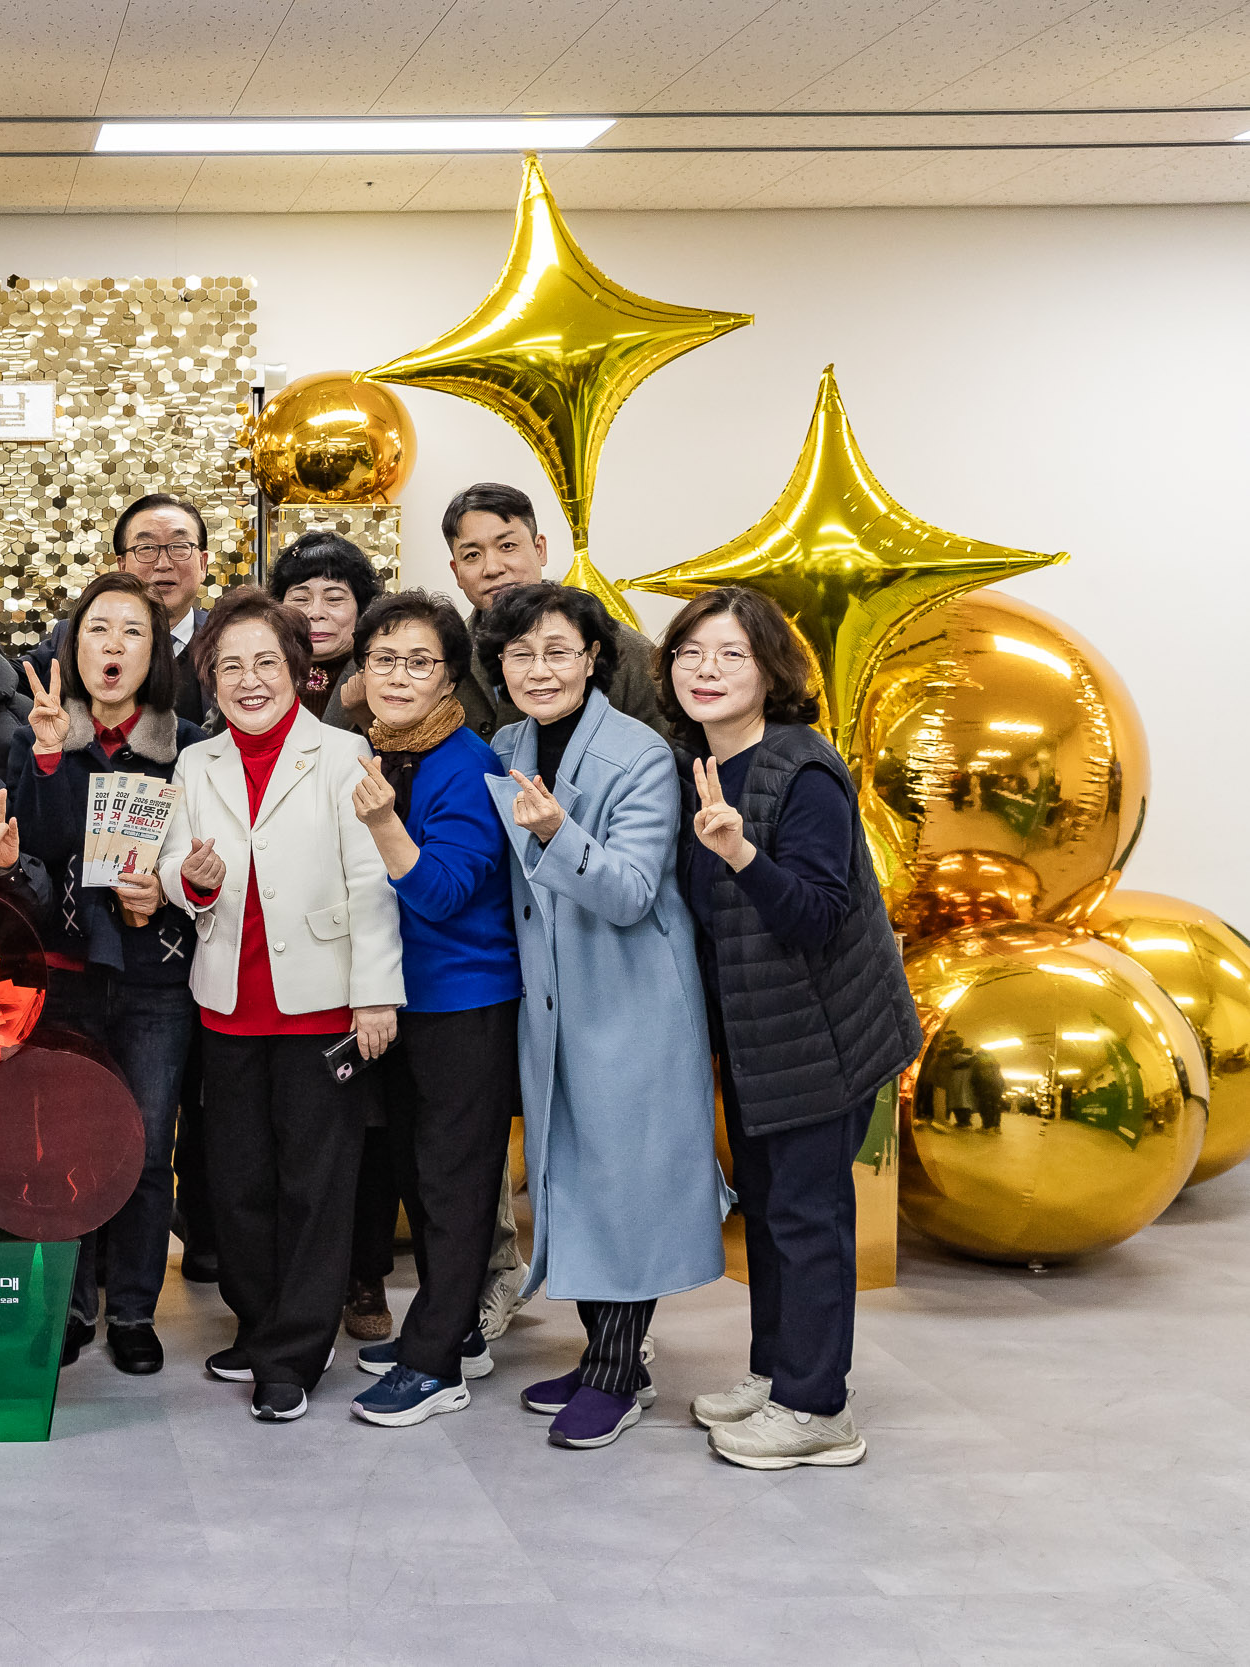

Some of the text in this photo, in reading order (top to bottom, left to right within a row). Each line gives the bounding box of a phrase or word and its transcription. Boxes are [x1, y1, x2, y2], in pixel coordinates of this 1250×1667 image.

[133, 796, 149, 805] 2026
[128, 803, 169, 821] 따뜻한
[125, 814, 165, 830] 겨울나기
